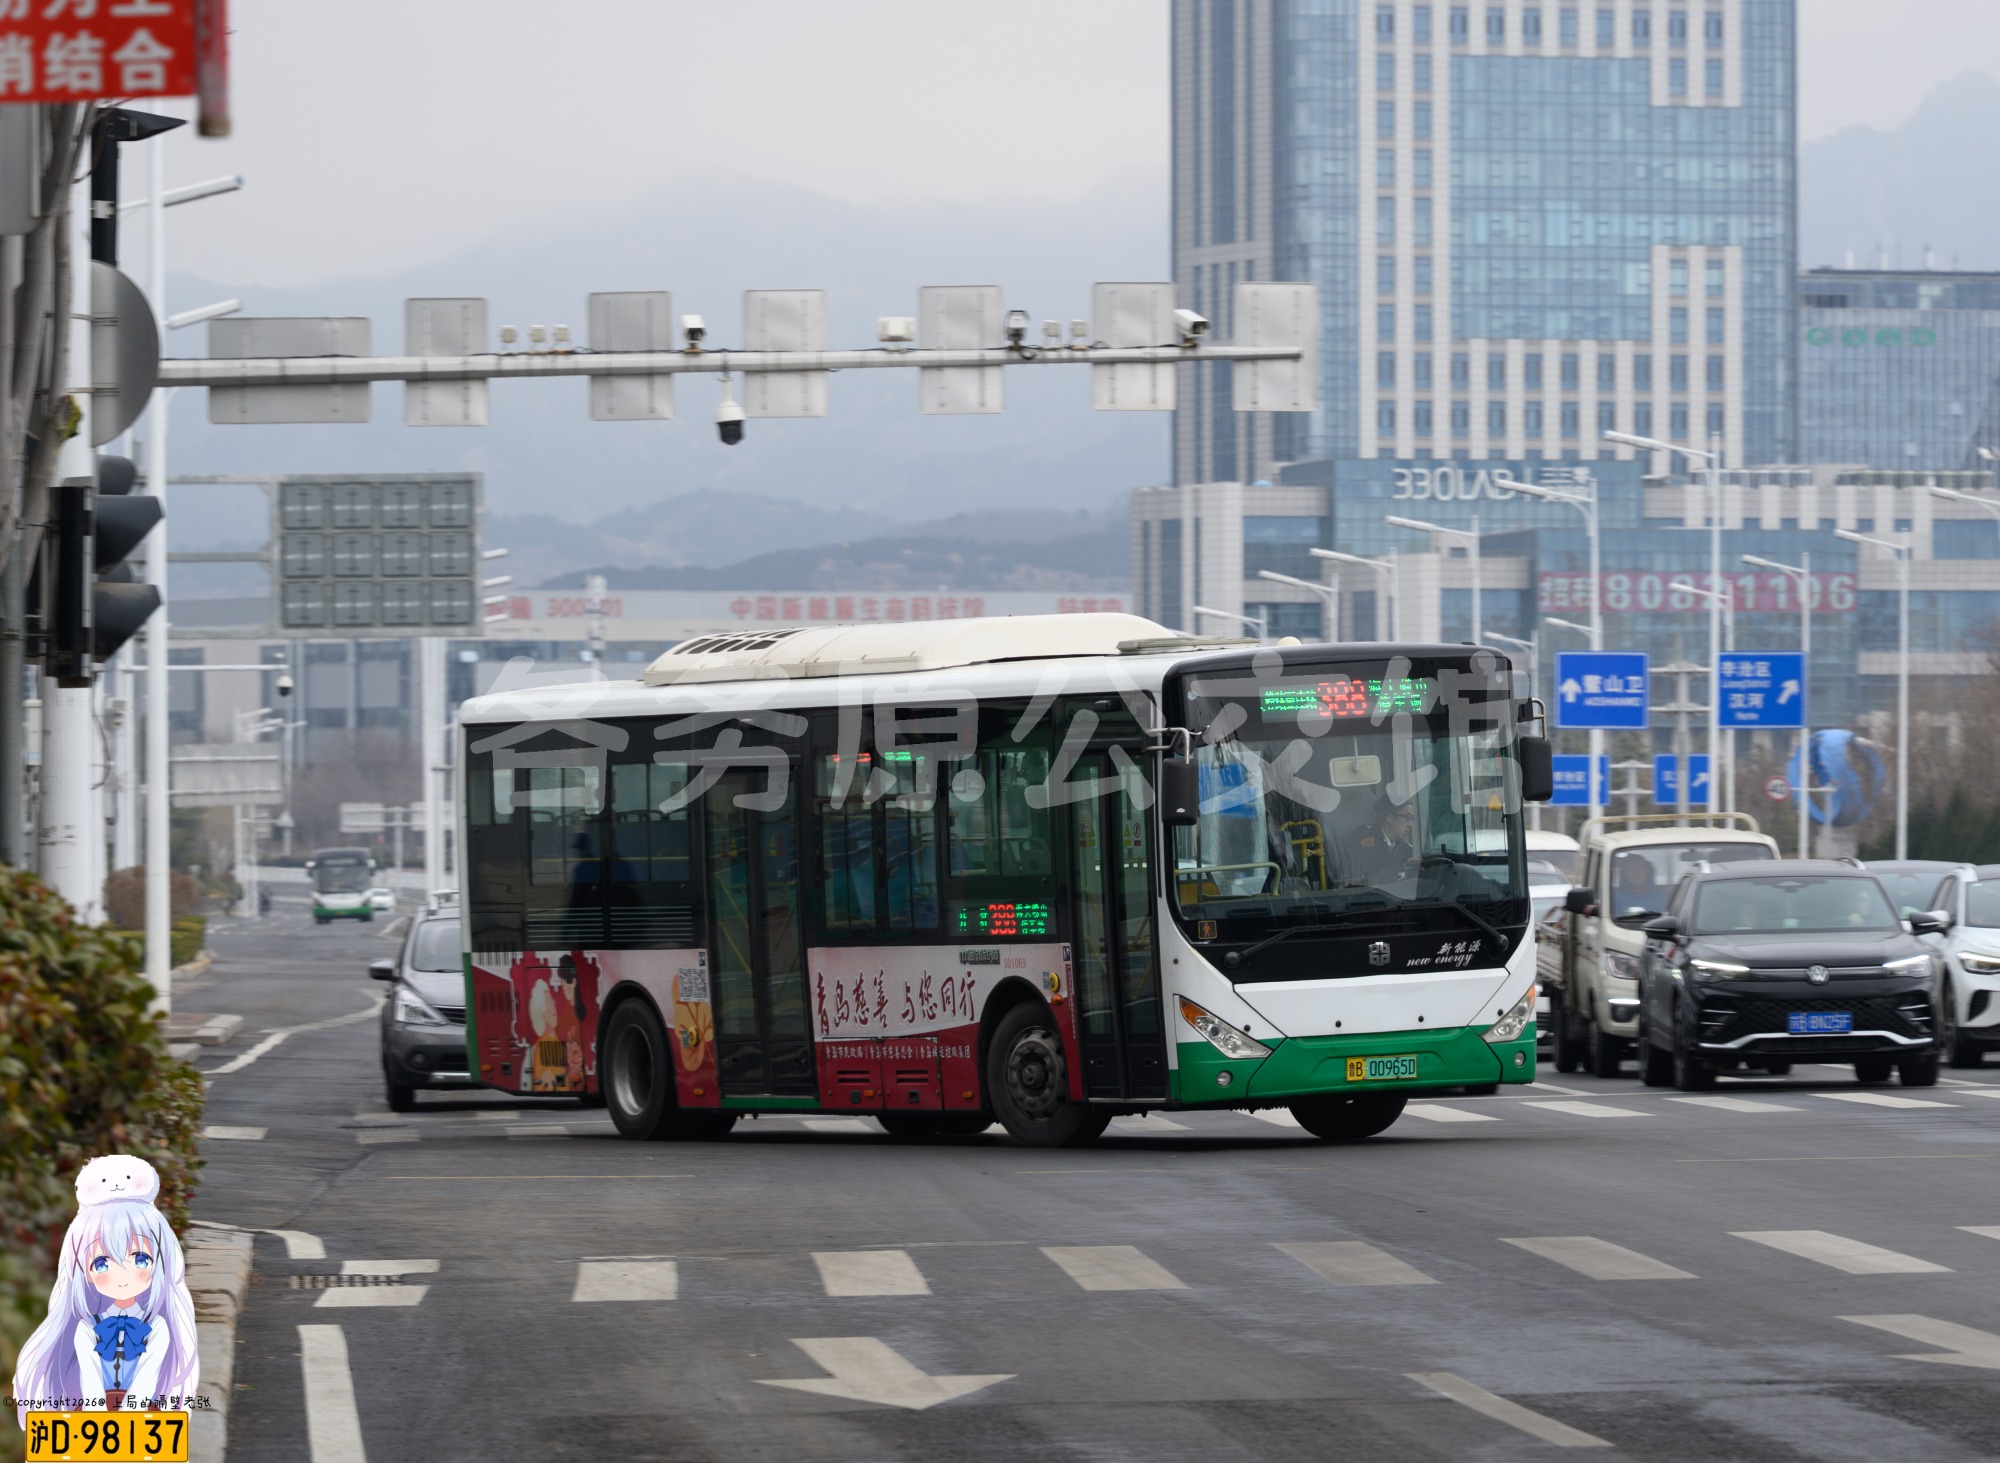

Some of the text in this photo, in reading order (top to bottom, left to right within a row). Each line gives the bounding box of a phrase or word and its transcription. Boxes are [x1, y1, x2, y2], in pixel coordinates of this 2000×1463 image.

[1392, 467, 1515, 500] 330LAB
[1437, 940, 1481, 955] 新能源
[1406, 953, 1474, 967] new energy
[816, 969, 976, 1035] 青岛慈善 与您同行
